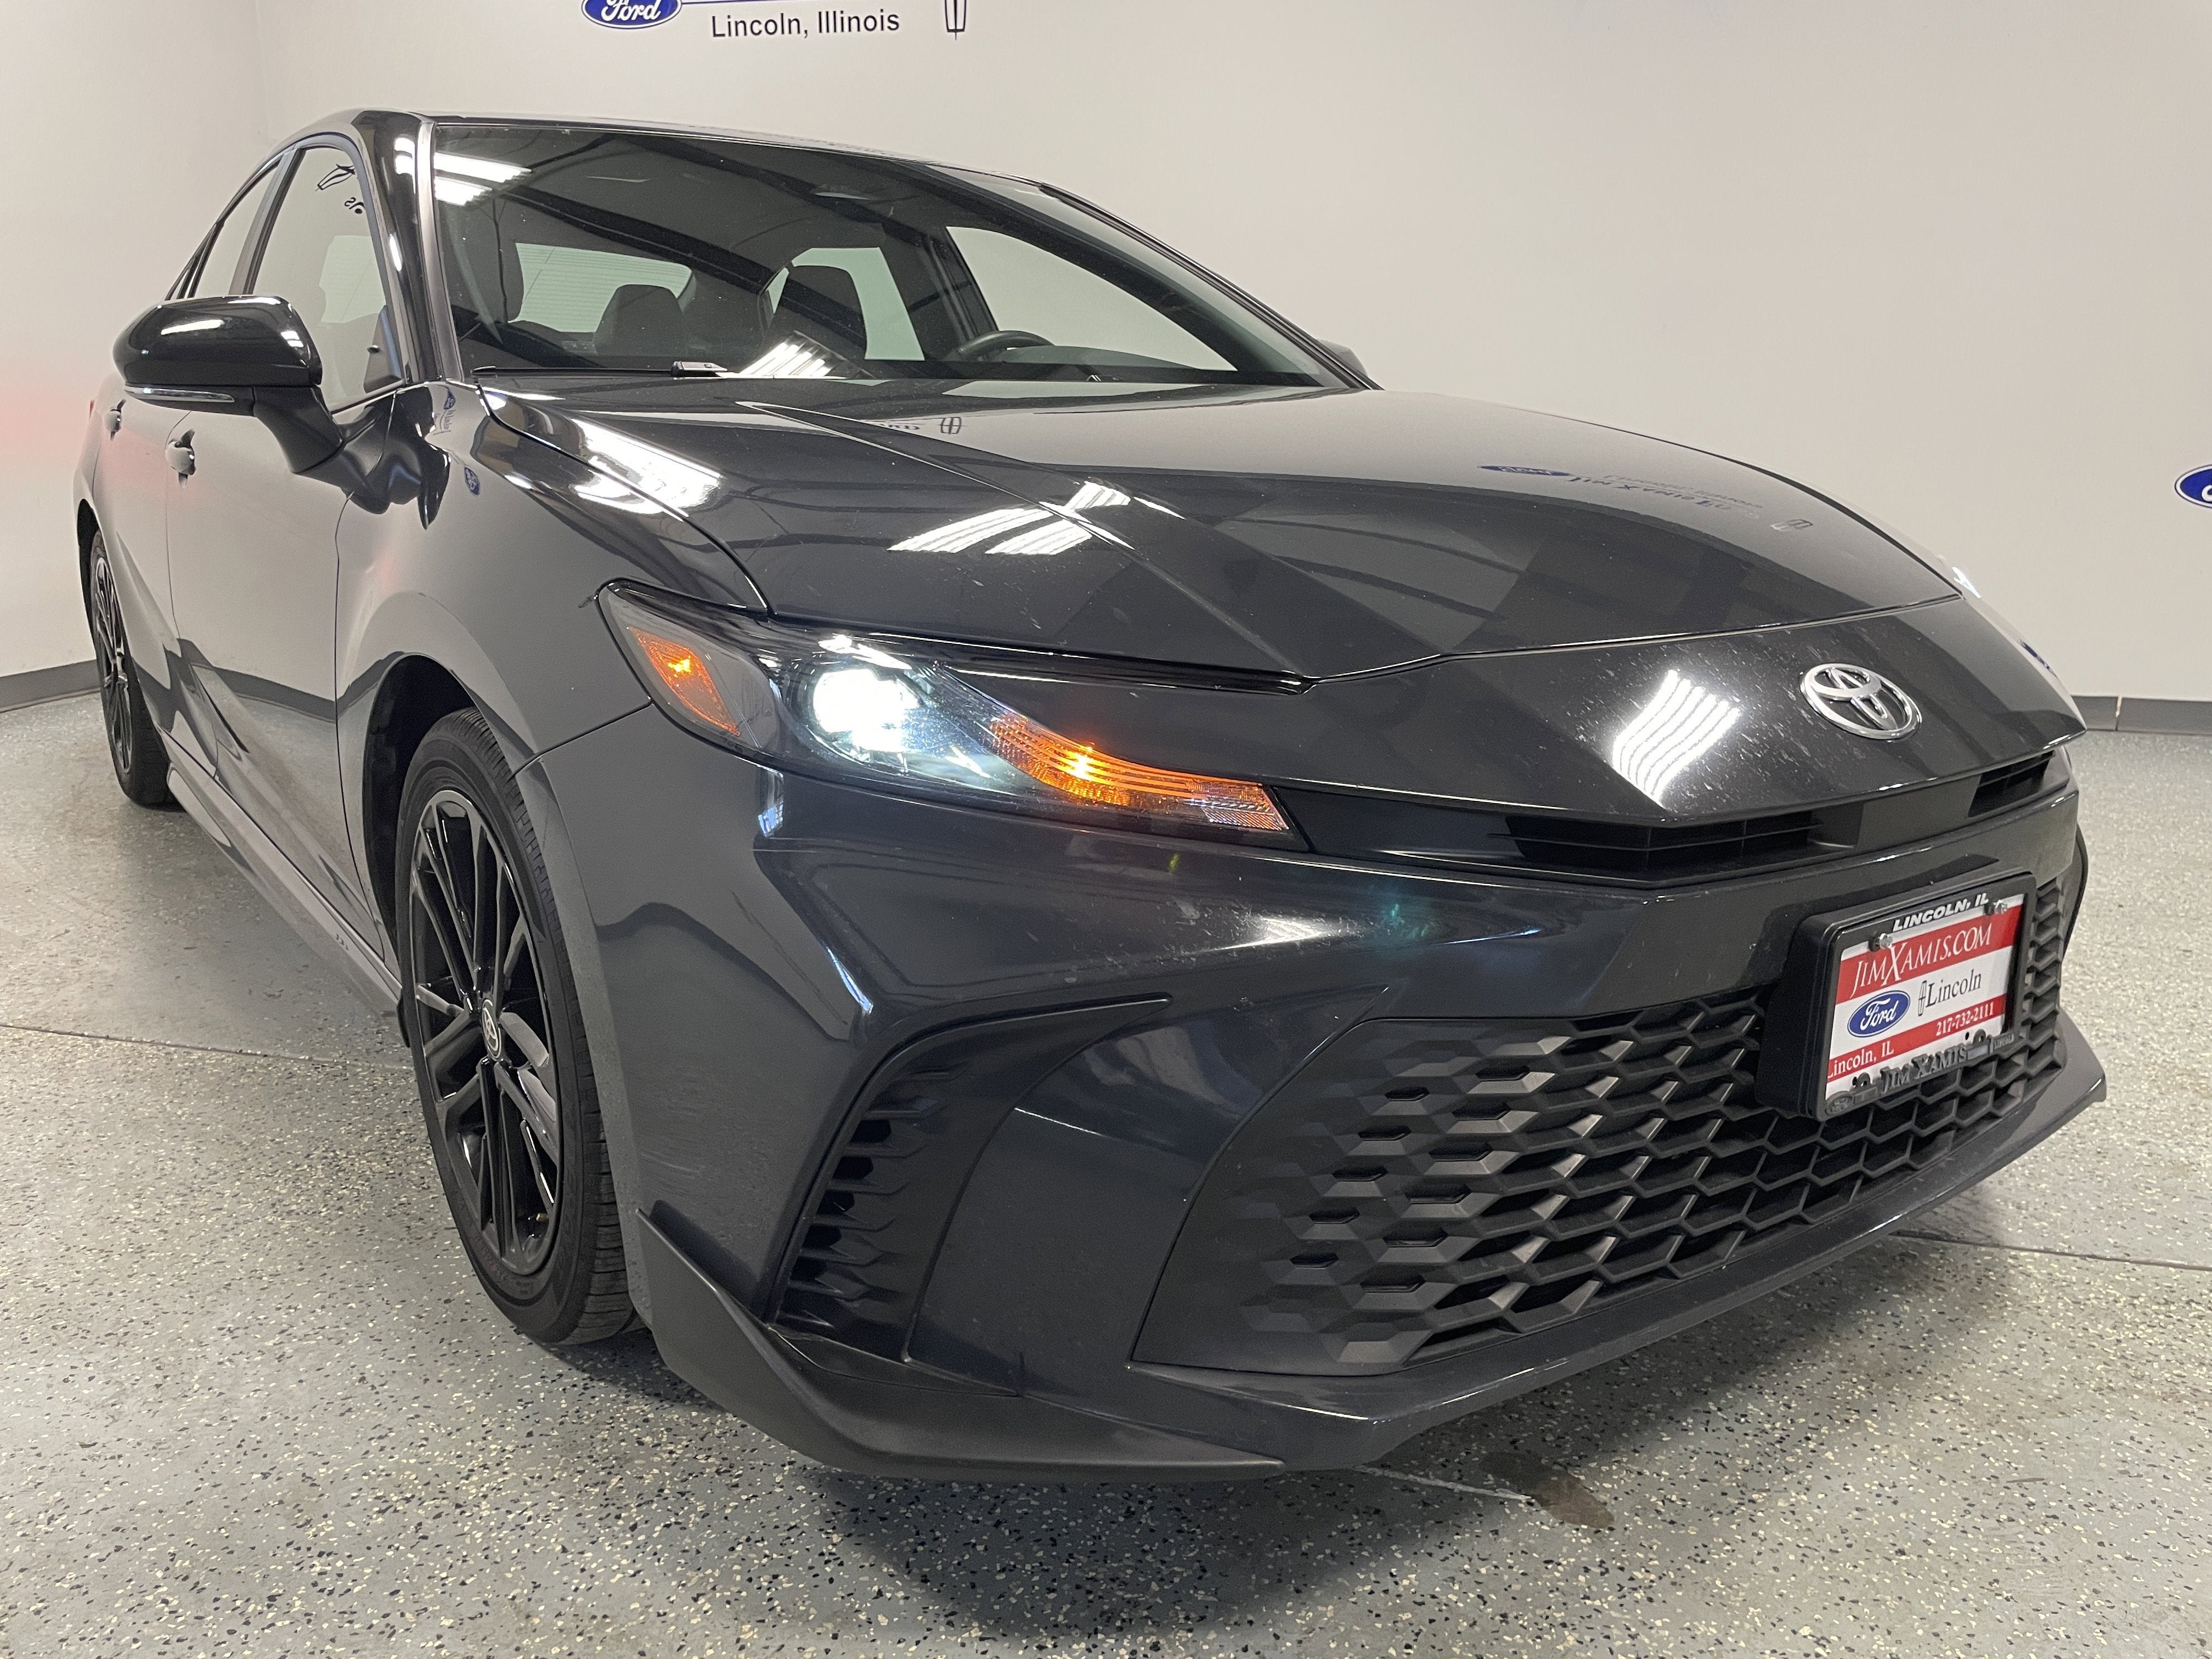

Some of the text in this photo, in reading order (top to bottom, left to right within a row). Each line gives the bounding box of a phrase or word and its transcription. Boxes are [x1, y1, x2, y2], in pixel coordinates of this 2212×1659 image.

[601, 0, 661, 21] Ford
[712, 9, 900, 38] Lincoln, Illinois
[1893, 893, 1989, 932] LINCOLN, IL
[1925, 969, 1982, 1008] Lincoln
[1860, 997, 1899, 1030] Ford
[1935, 1001, 1994, 1036] 217-732-2111
[1881, 1040, 1894, 1057] IL
